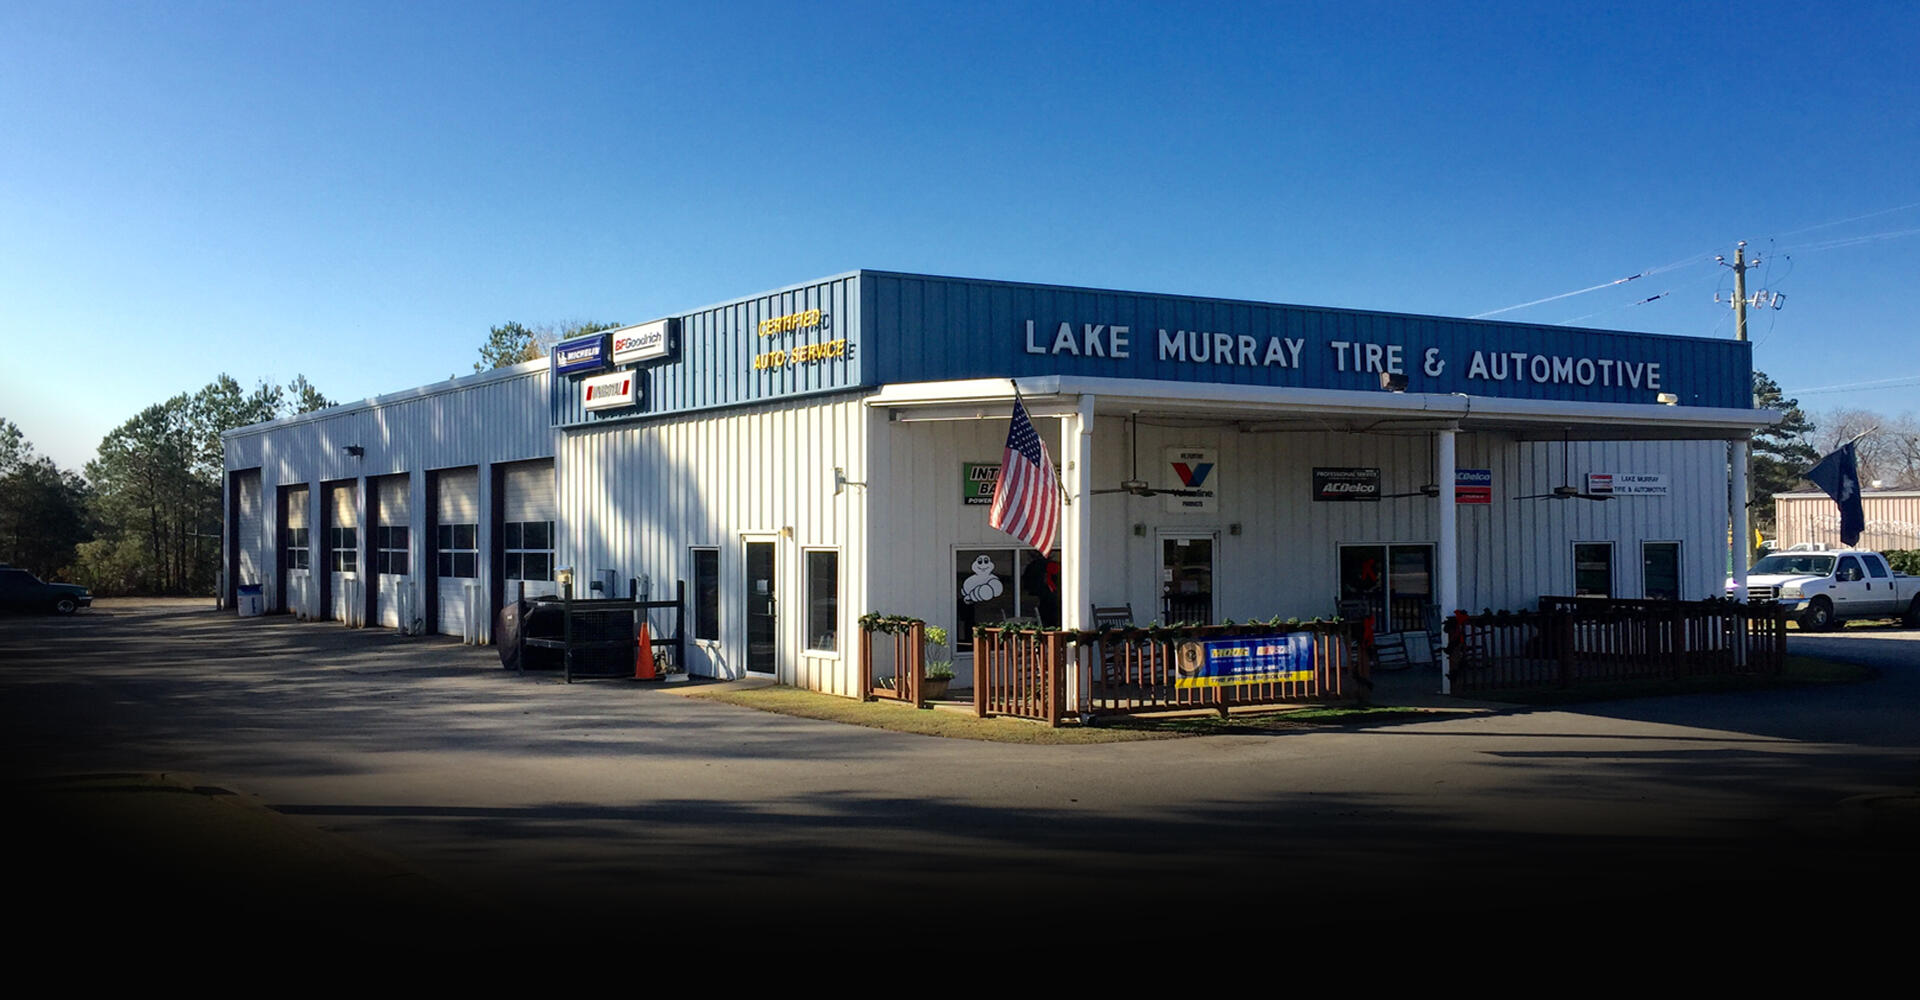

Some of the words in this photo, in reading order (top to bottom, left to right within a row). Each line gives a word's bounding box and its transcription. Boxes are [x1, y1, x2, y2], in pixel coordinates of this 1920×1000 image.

[758, 309, 820, 337] CERTIFIED
[567, 346, 600, 361] MICHELIN
[615, 331, 662, 352] BFGoodrich
[754, 350, 786, 370] AUTO
[791, 338, 846, 363] SERVICE
[1026, 319, 1129, 358] LAKE
[1158, 328, 1305, 369] MURRAY
[1331, 341, 1403, 374] TIRE
[1423, 347, 1445, 377] &
[1468, 350, 1661, 390] AUTOMOTIVE
[1322, 482, 1375, 493] ACDelco
